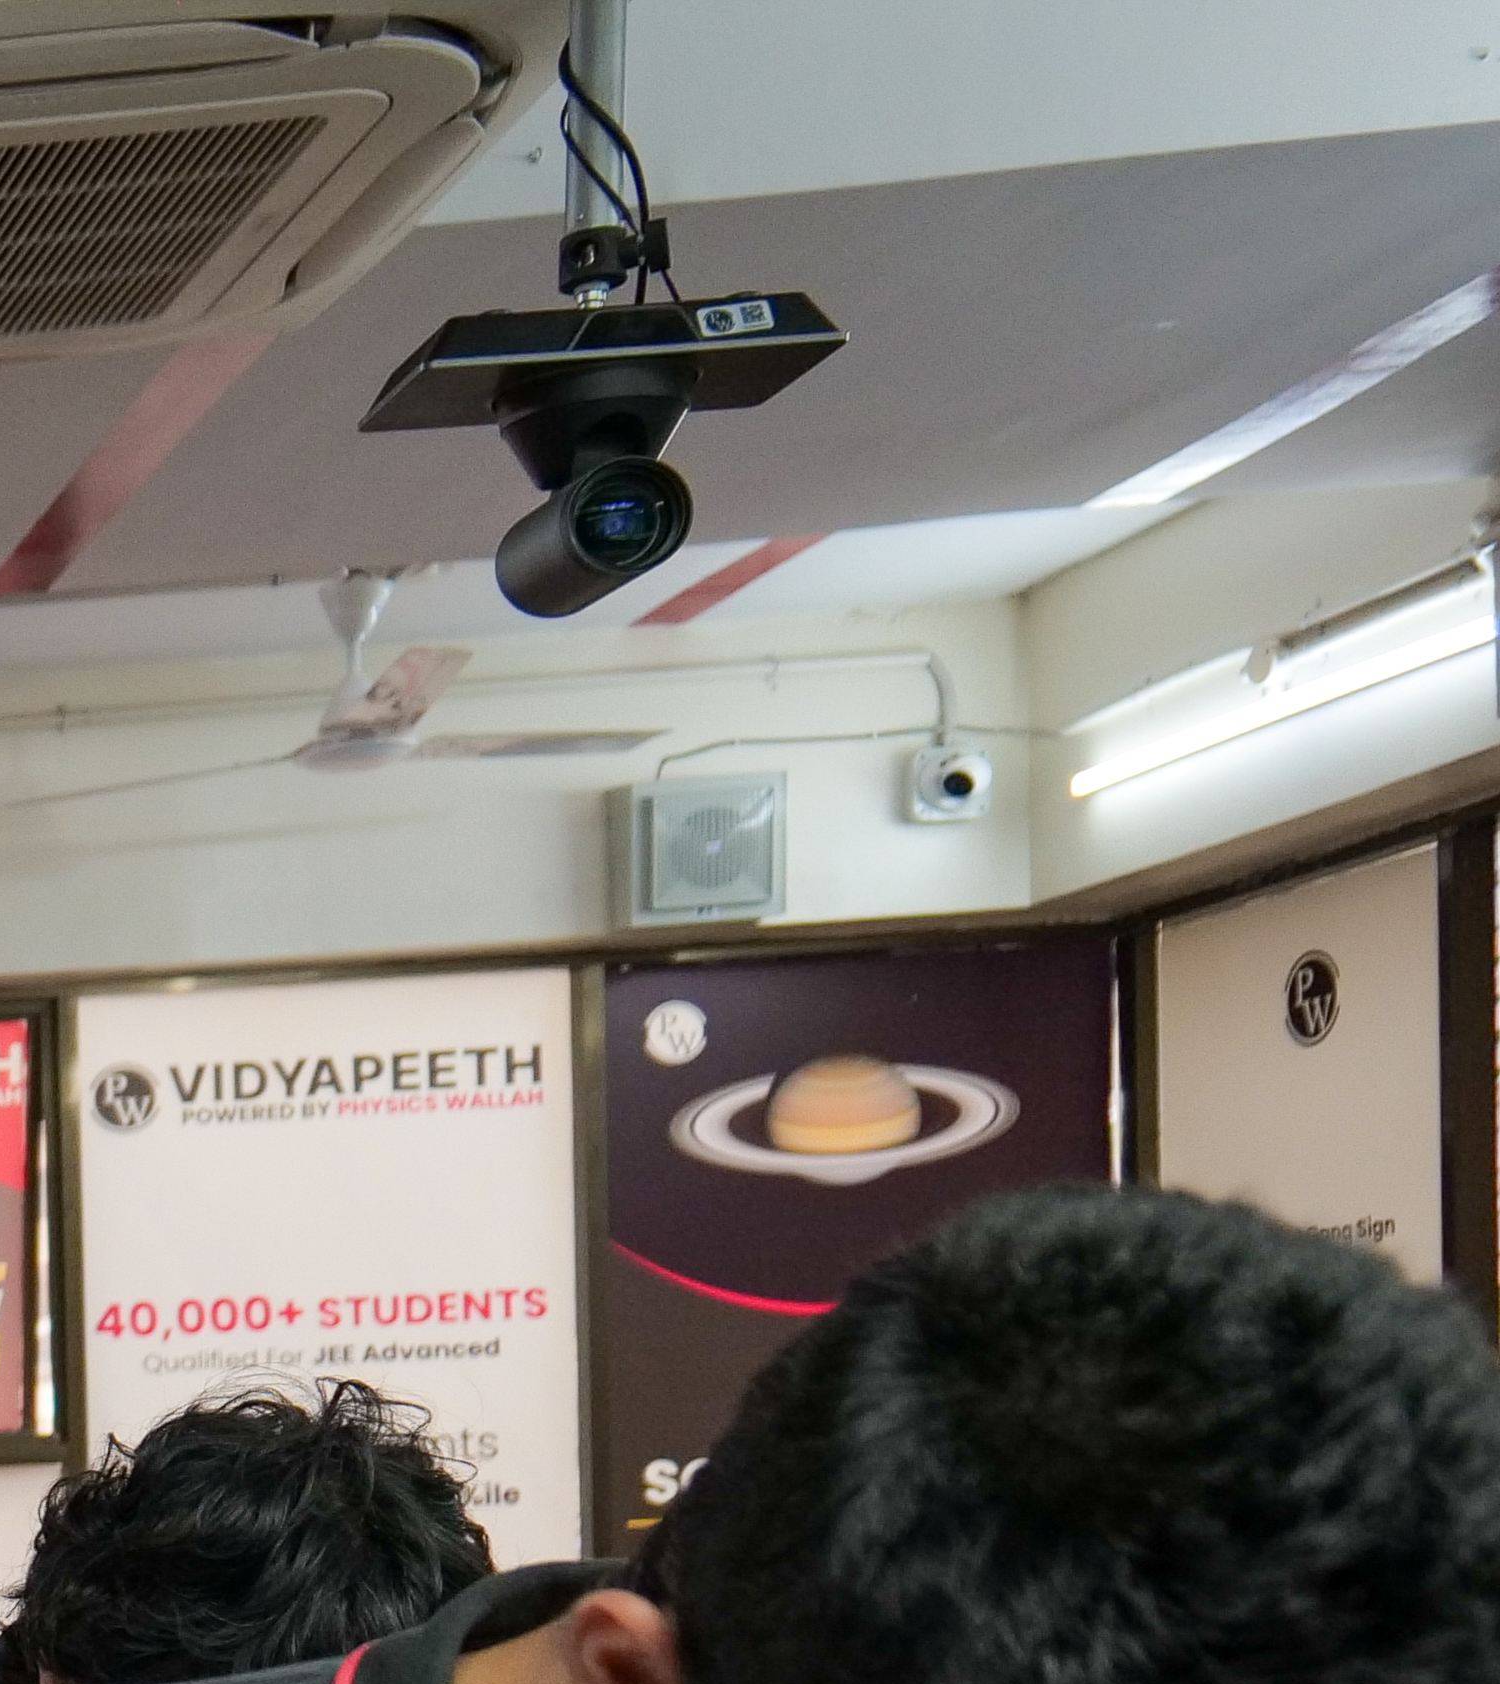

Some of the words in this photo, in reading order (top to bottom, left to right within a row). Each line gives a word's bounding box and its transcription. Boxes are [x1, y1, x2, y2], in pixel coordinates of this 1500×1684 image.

[1295, 965, 1334, 1036] PW
[100, 1070, 154, 1129] PW
[169, 1044, 543, 1104] VIDYAPEETH
[181, 1101, 294, 1126] POWERED
[302, 1101, 330, 1118] BY
[337, 1095, 438, 1117] PHYSICS
[446, 1089, 546, 1112] WALLAH
[1356, 1214, 1396, 1244] Sign
[95, 1296, 303, 1341] 40,000+
[317, 1287, 550, 1329] STUDENTS
[312, 1343, 354, 1365] JEE
[361, 1337, 501, 1363] Advanced
